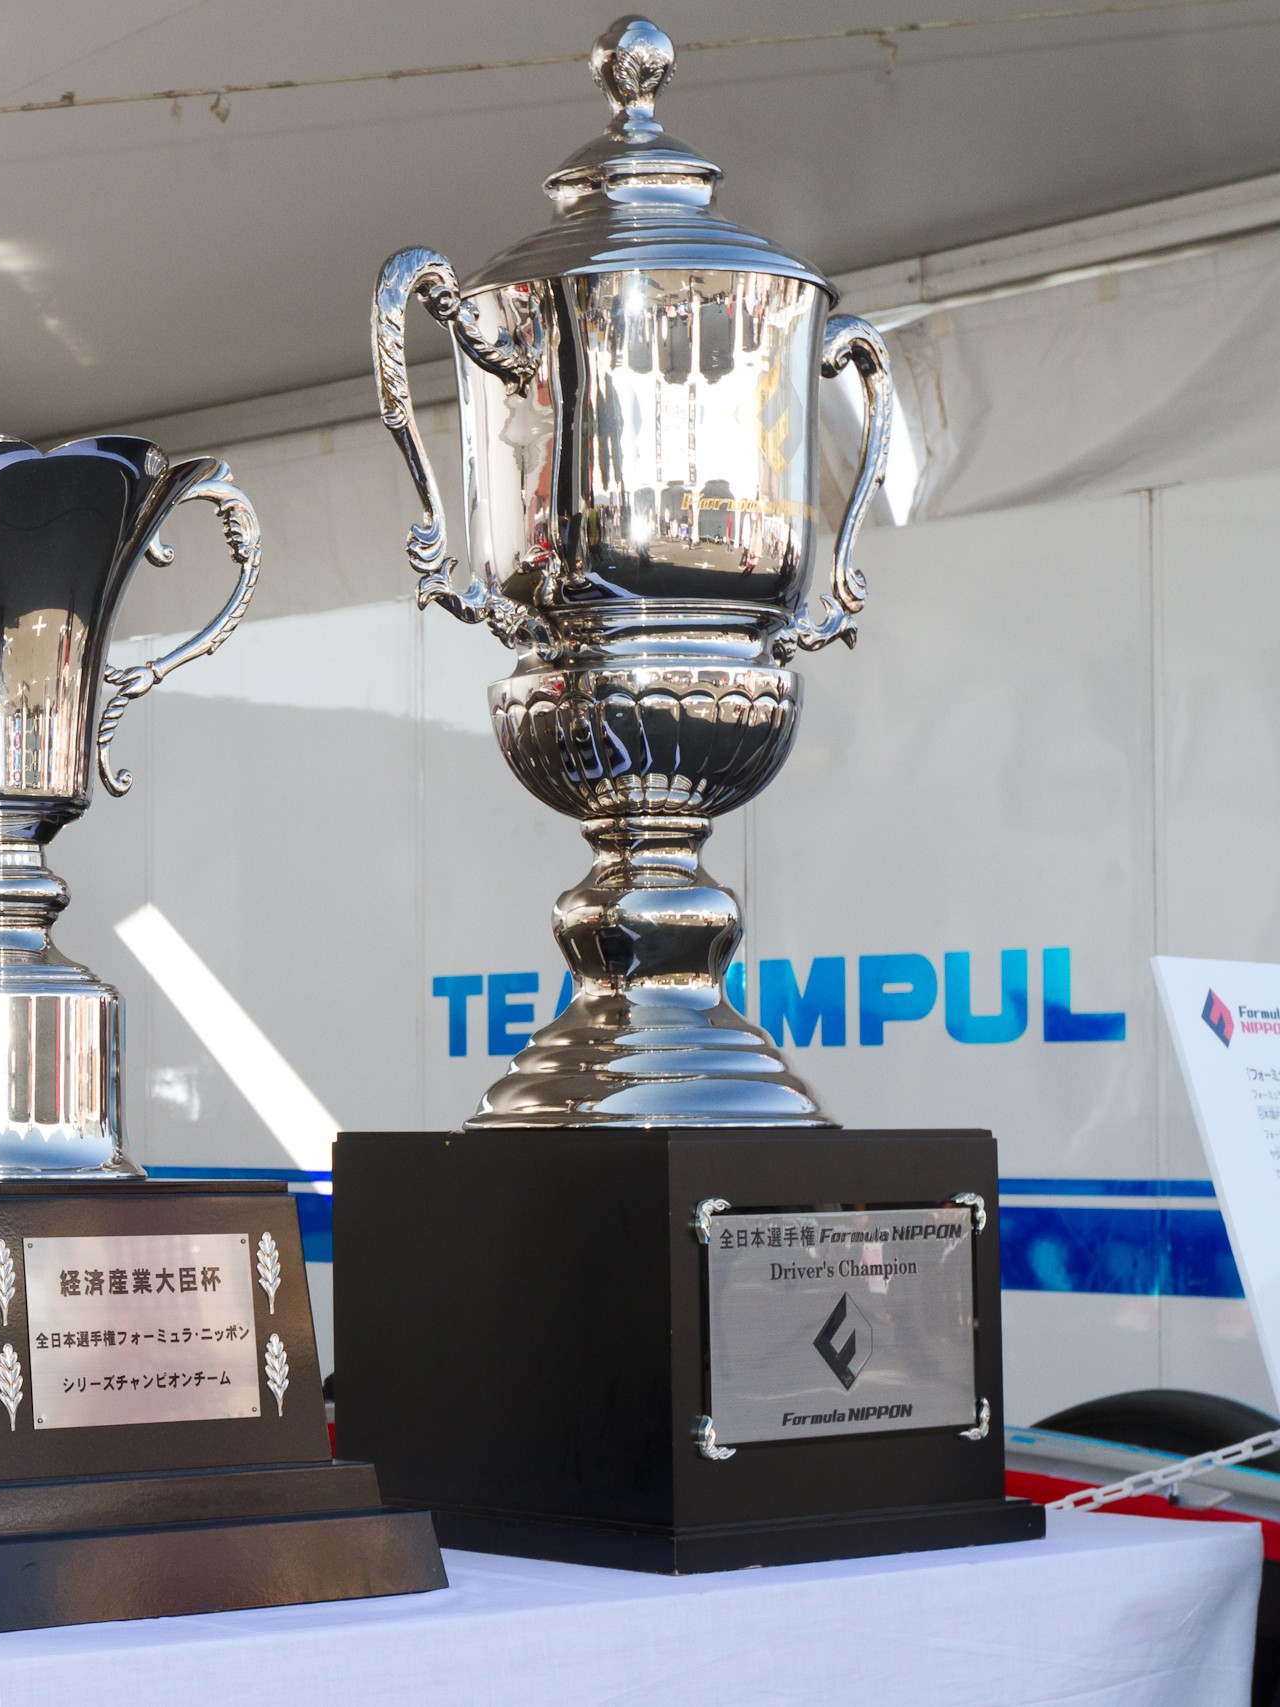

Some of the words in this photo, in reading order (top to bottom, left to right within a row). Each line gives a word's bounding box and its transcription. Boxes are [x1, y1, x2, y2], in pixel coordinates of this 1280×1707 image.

[720, 1226, 816, 1249] 全日本選手権
[820, 1227, 890, 1243] Formula
[892, 1223, 962, 1241] NIPPON
[770, 1260, 835, 1280] Driver's
[838, 1258, 918, 1279] Champion
[59, 1266, 221, 1297] 経済産業大臣杯
[63, 1370, 231, 1393] シリーズチャンピオンチーム
[782, 1409, 846, 1426] Formula
[848, 1403, 913, 1422] NIPPON
